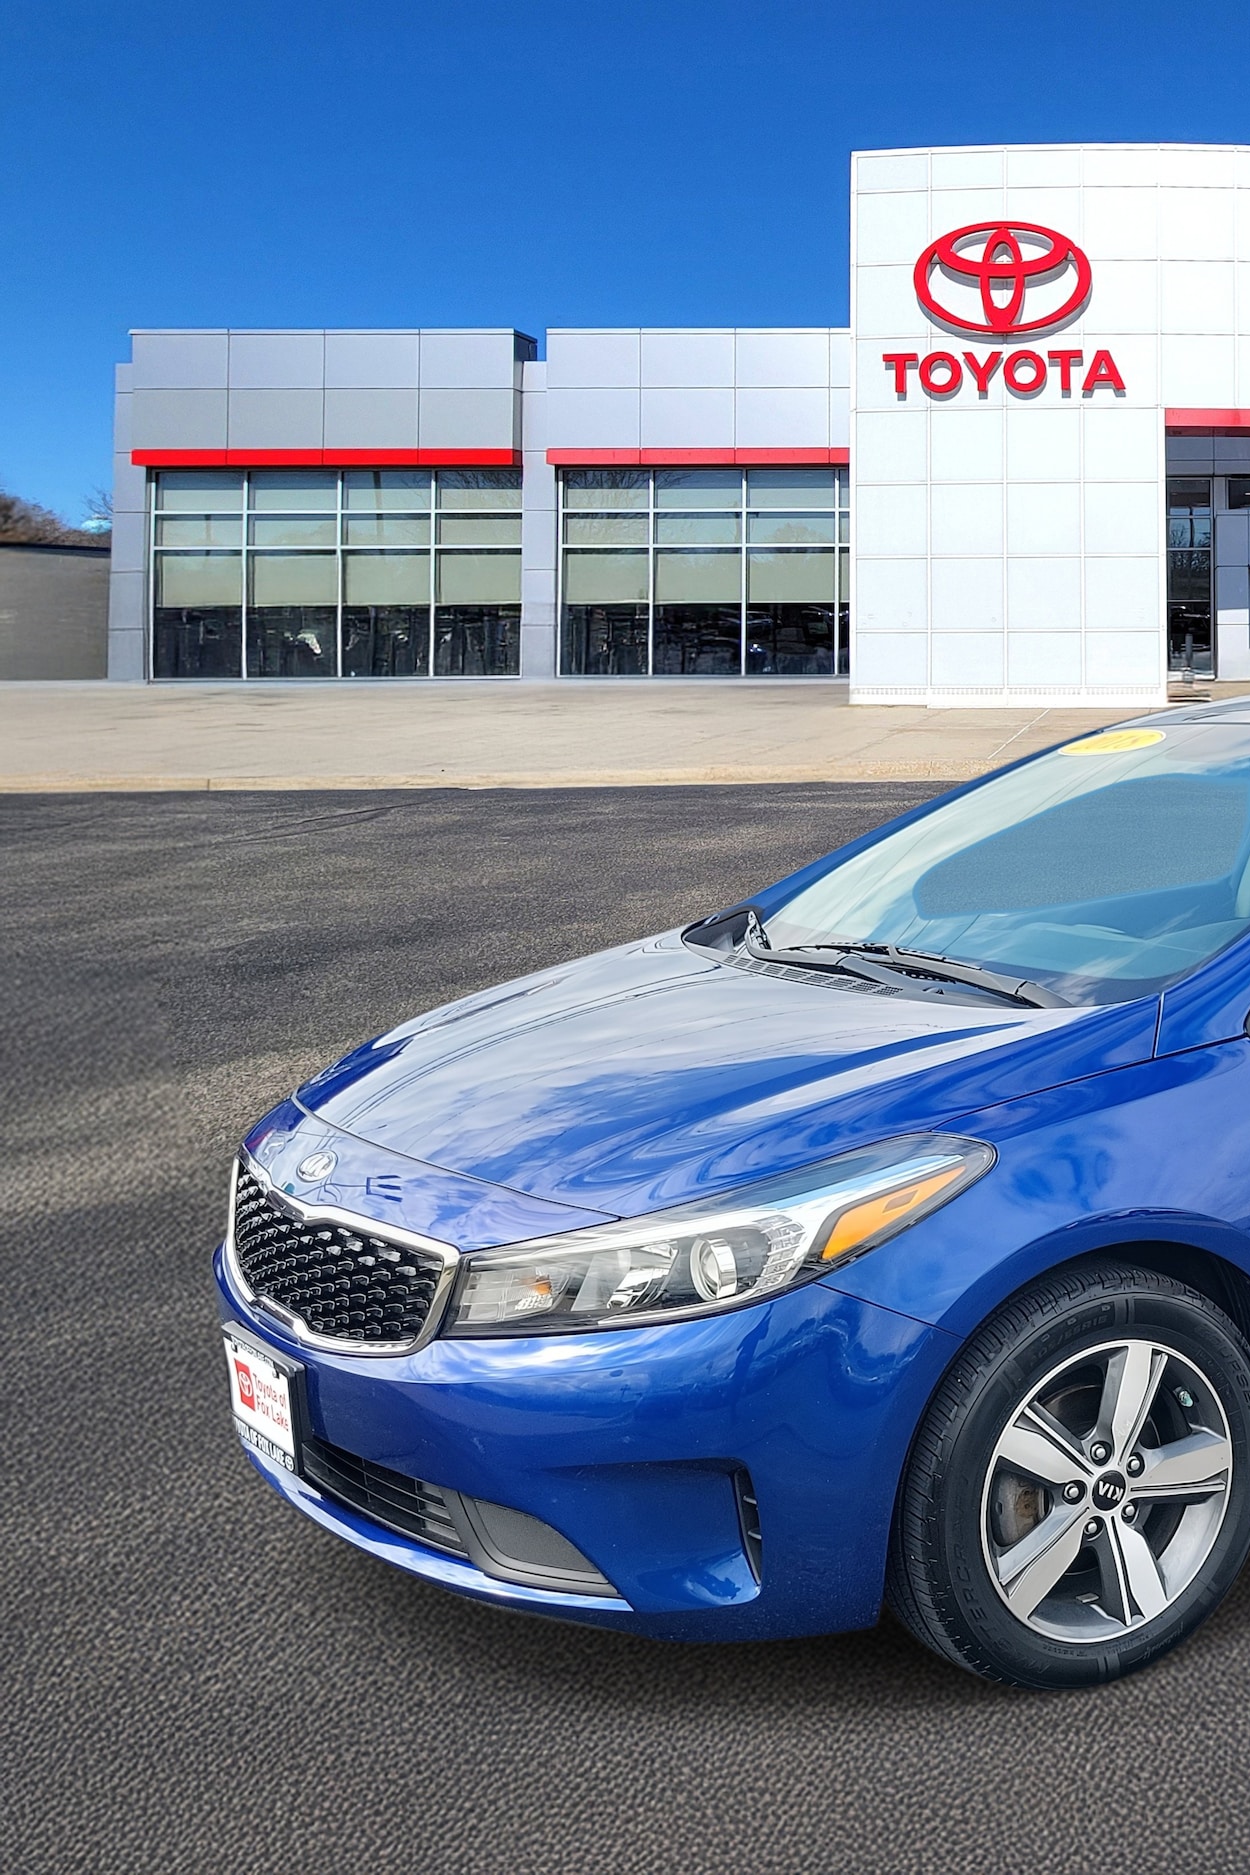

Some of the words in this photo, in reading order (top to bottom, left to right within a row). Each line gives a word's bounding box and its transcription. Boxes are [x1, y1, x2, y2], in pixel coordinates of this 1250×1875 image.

[882, 350, 1126, 397] TOYOTA
[253, 1372, 278, 1403] Toyota
[279, 1393, 287, 1410] of
[256, 1394, 270, 1418] Fox
[271, 1404, 289, 1432] Lake
[1098, 1480, 1124, 1501] KIA
